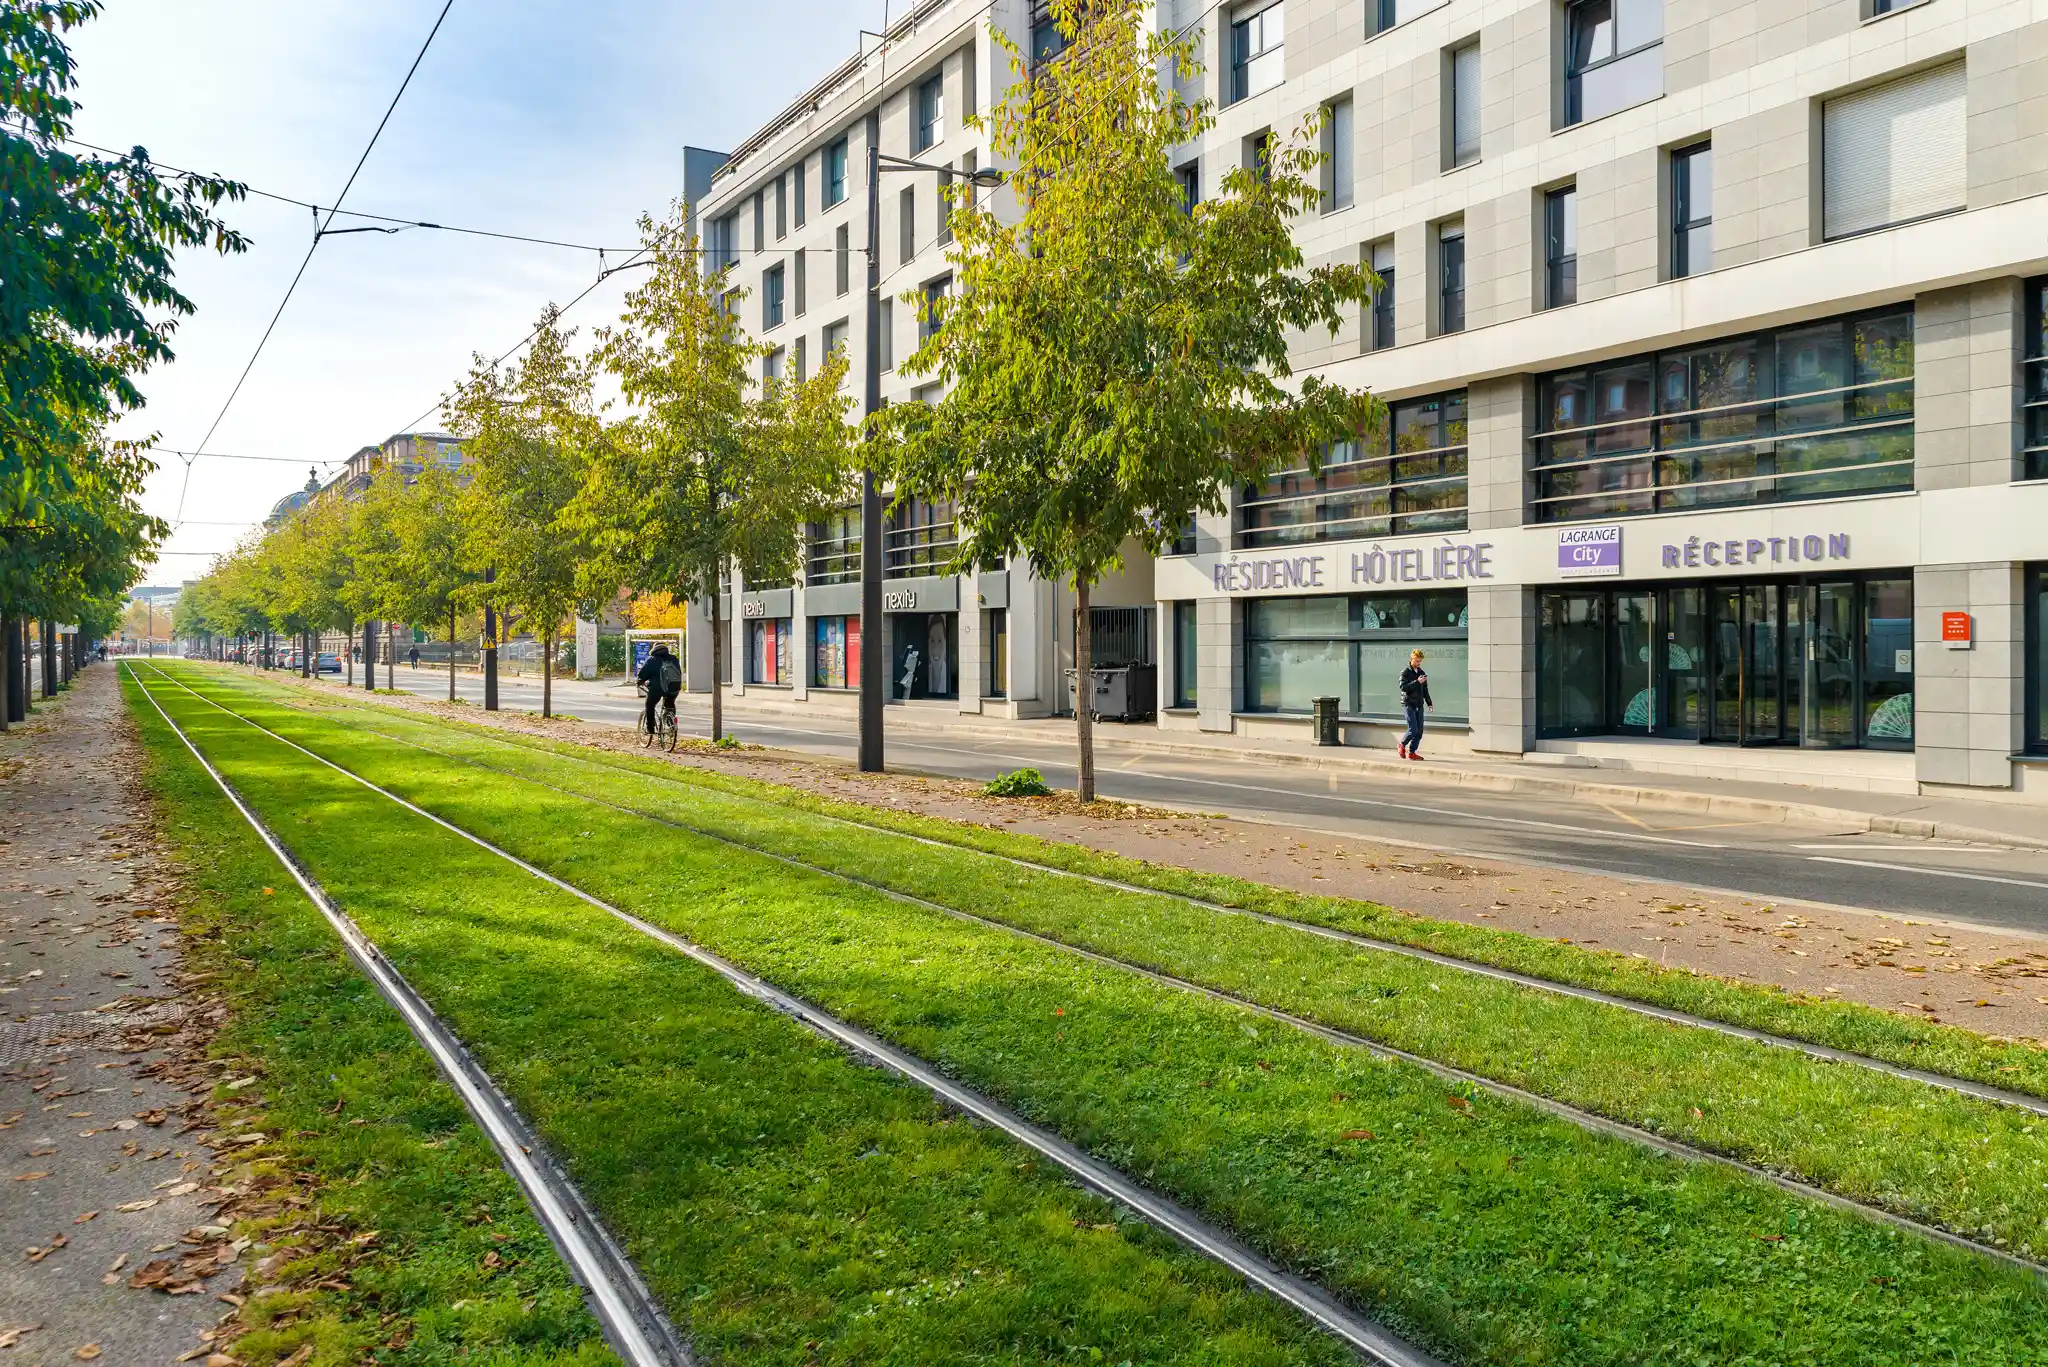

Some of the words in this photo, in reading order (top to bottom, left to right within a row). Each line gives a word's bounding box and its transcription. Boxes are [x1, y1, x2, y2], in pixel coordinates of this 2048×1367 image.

[1561, 529, 1616, 543] LAGRANGE
[1662, 533, 1848, 567] RÉCEPTION
[1214, 555, 1324, 591] RÉSIDENCE
[1351, 538, 1494, 583] HÔTELIÈRE
[743, 600, 765, 616] nexity
[884, 589, 916, 609] nexity
